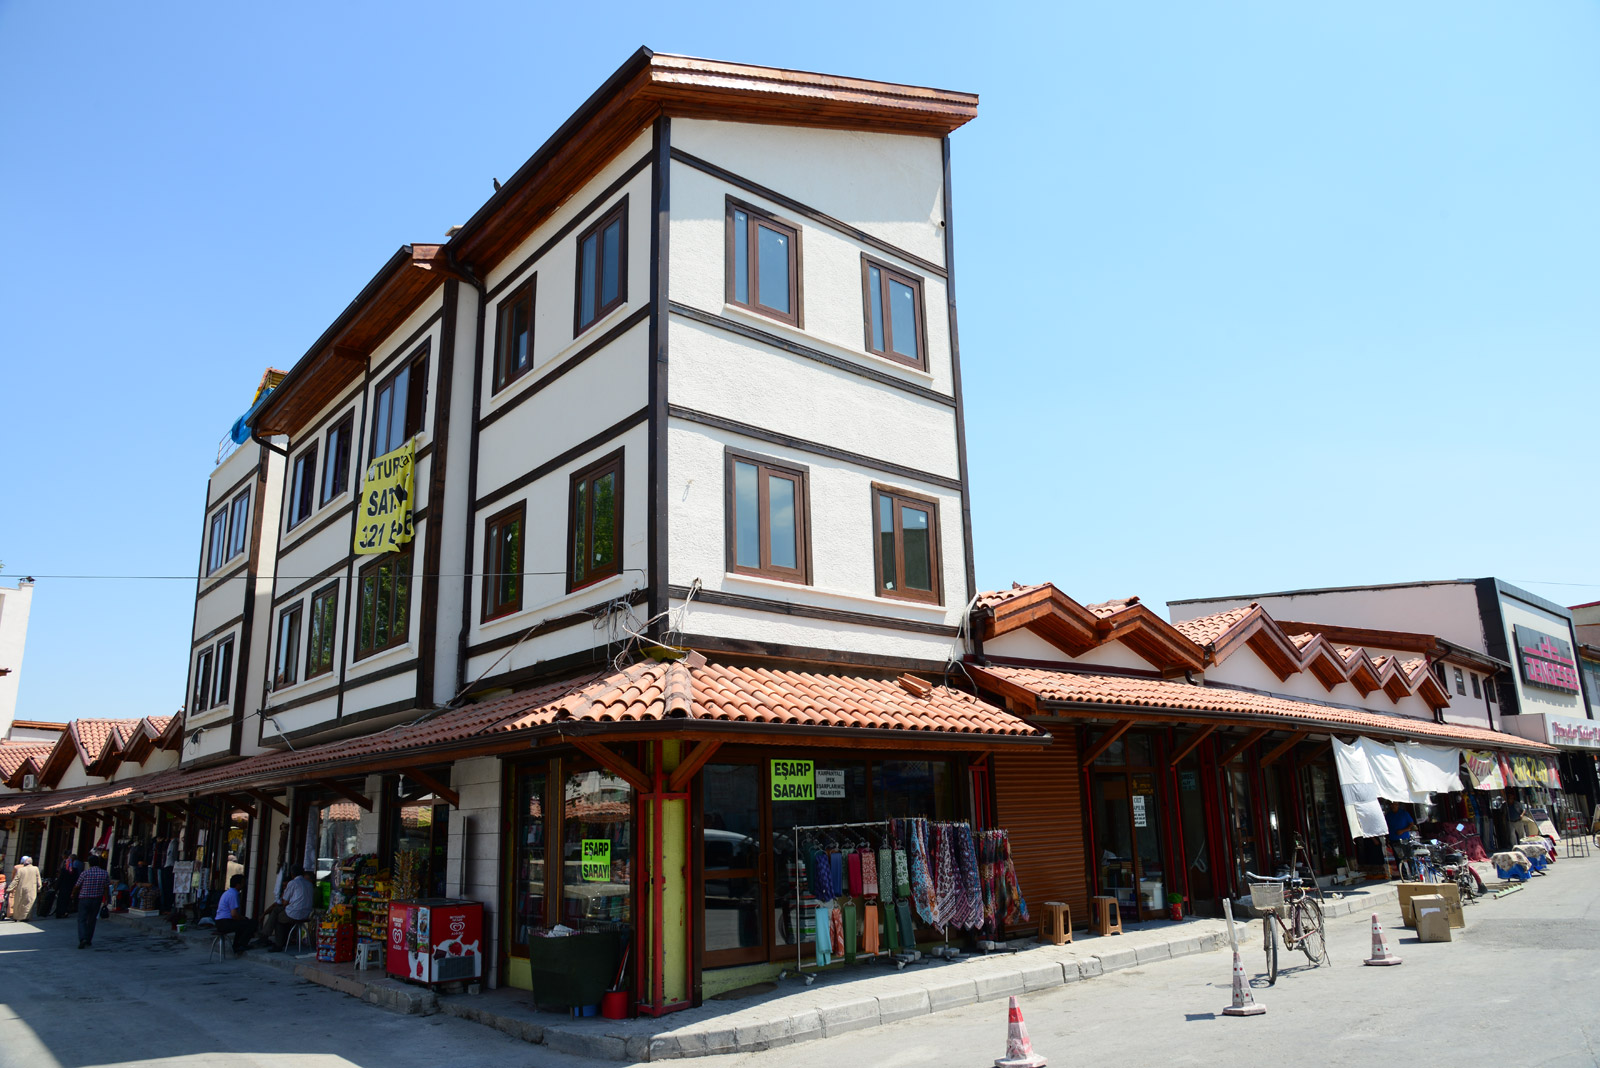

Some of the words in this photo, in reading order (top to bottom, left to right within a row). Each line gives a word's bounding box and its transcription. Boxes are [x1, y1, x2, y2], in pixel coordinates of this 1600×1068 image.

[774, 762, 811, 780] EŞARP
[773, 784, 812, 798] SARAYI
[584, 842, 609, 860] EŞARP
[583, 864, 610, 878] SARAYI
